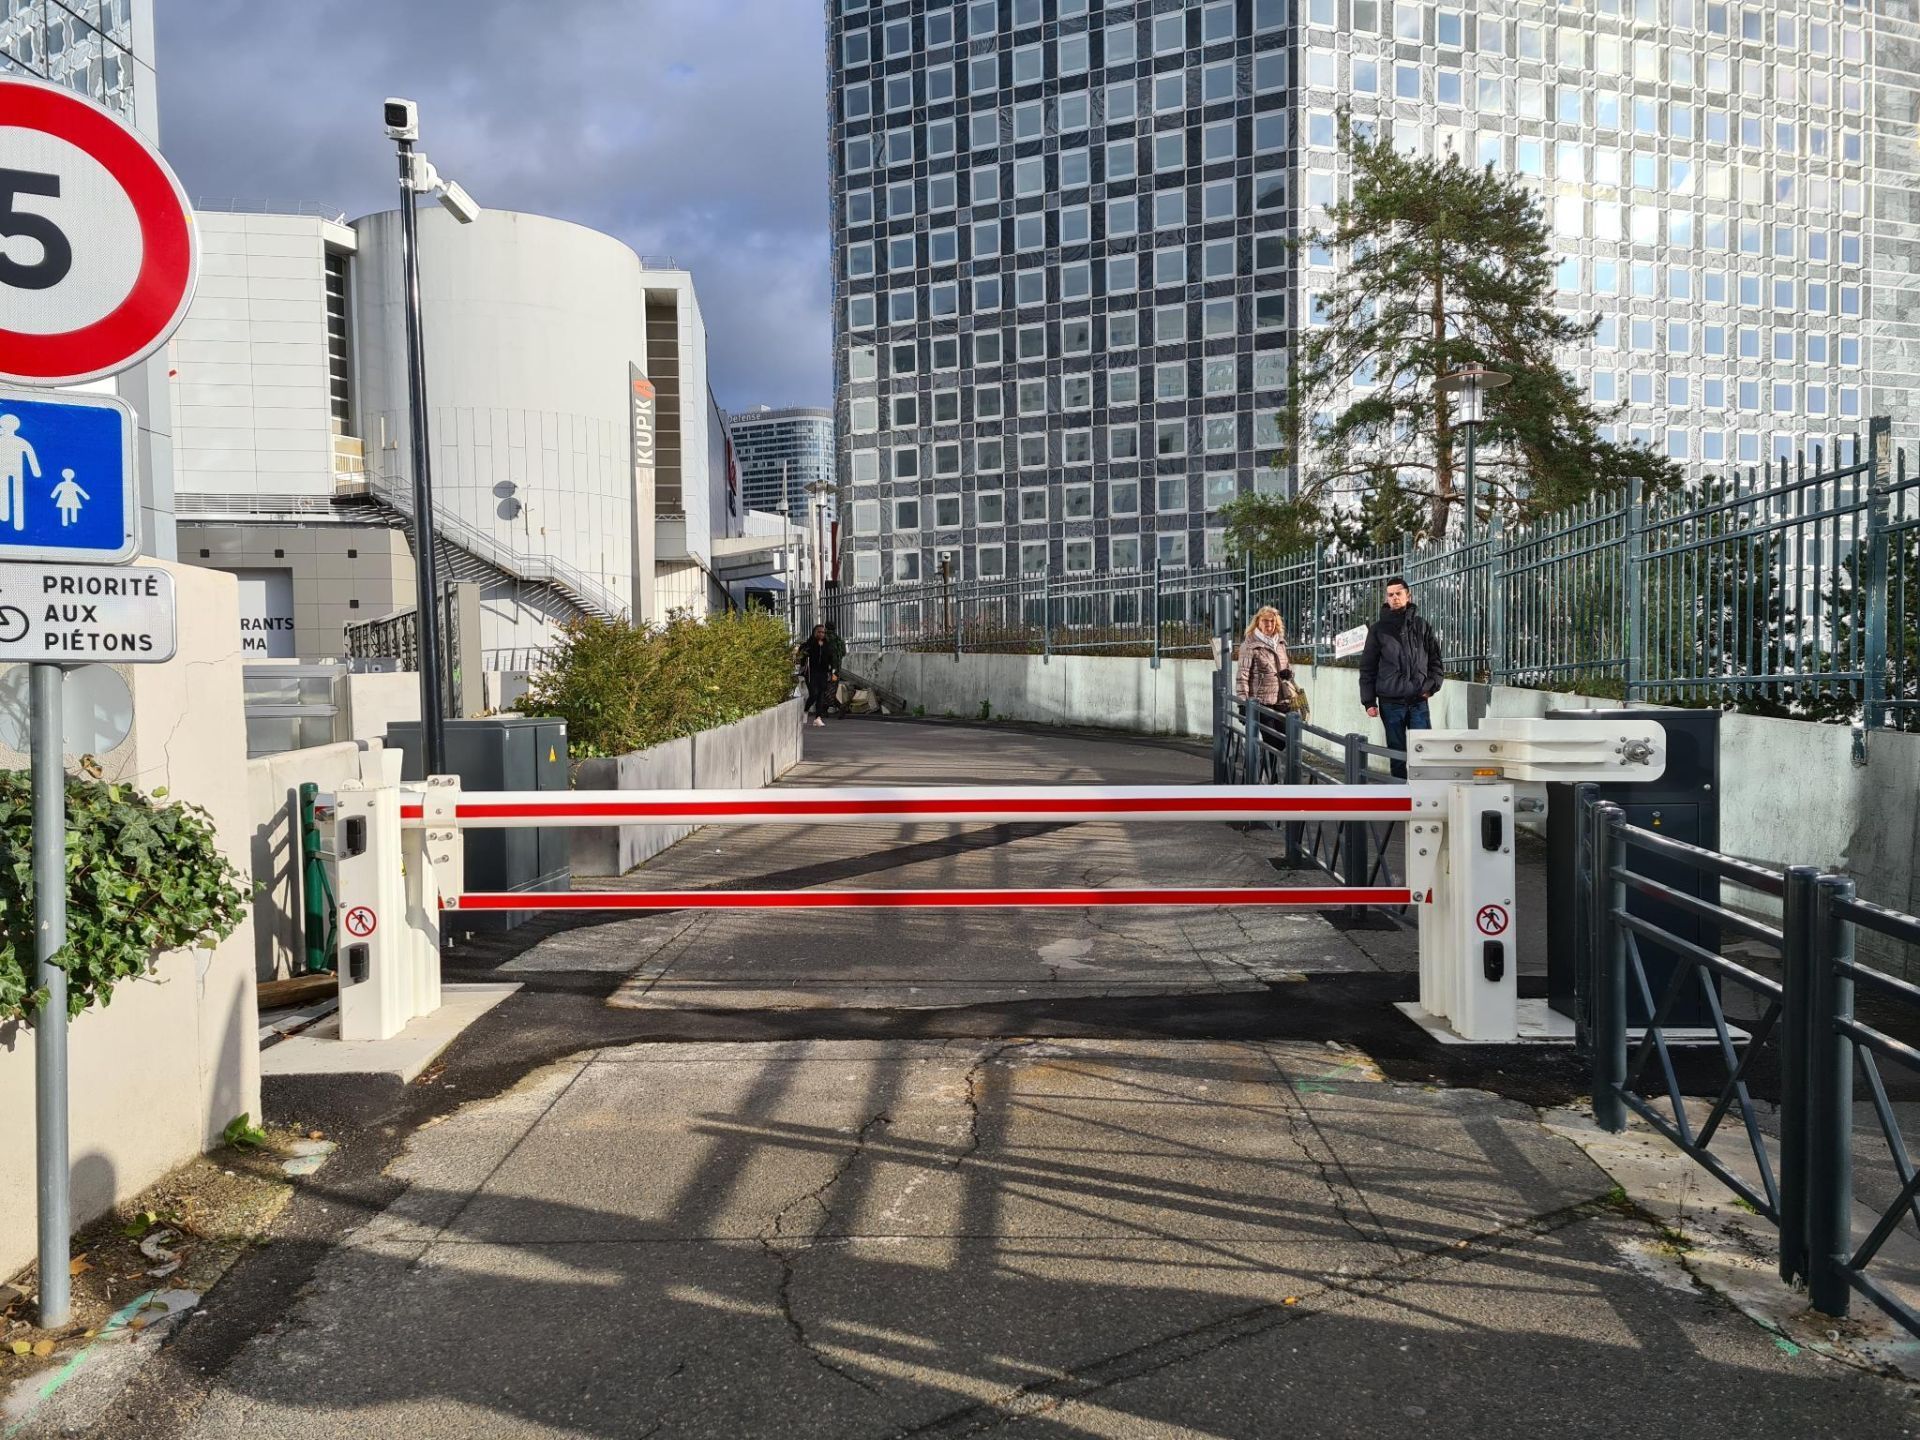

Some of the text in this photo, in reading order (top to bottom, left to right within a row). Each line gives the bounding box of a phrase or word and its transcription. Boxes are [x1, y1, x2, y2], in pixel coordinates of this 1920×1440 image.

[633, 379, 655, 465] KUPKA
[43, 575, 159, 597] PRIORITÉ
[44, 604, 98, 623] AUX
[44, 629, 153, 651] PIÉTONS
